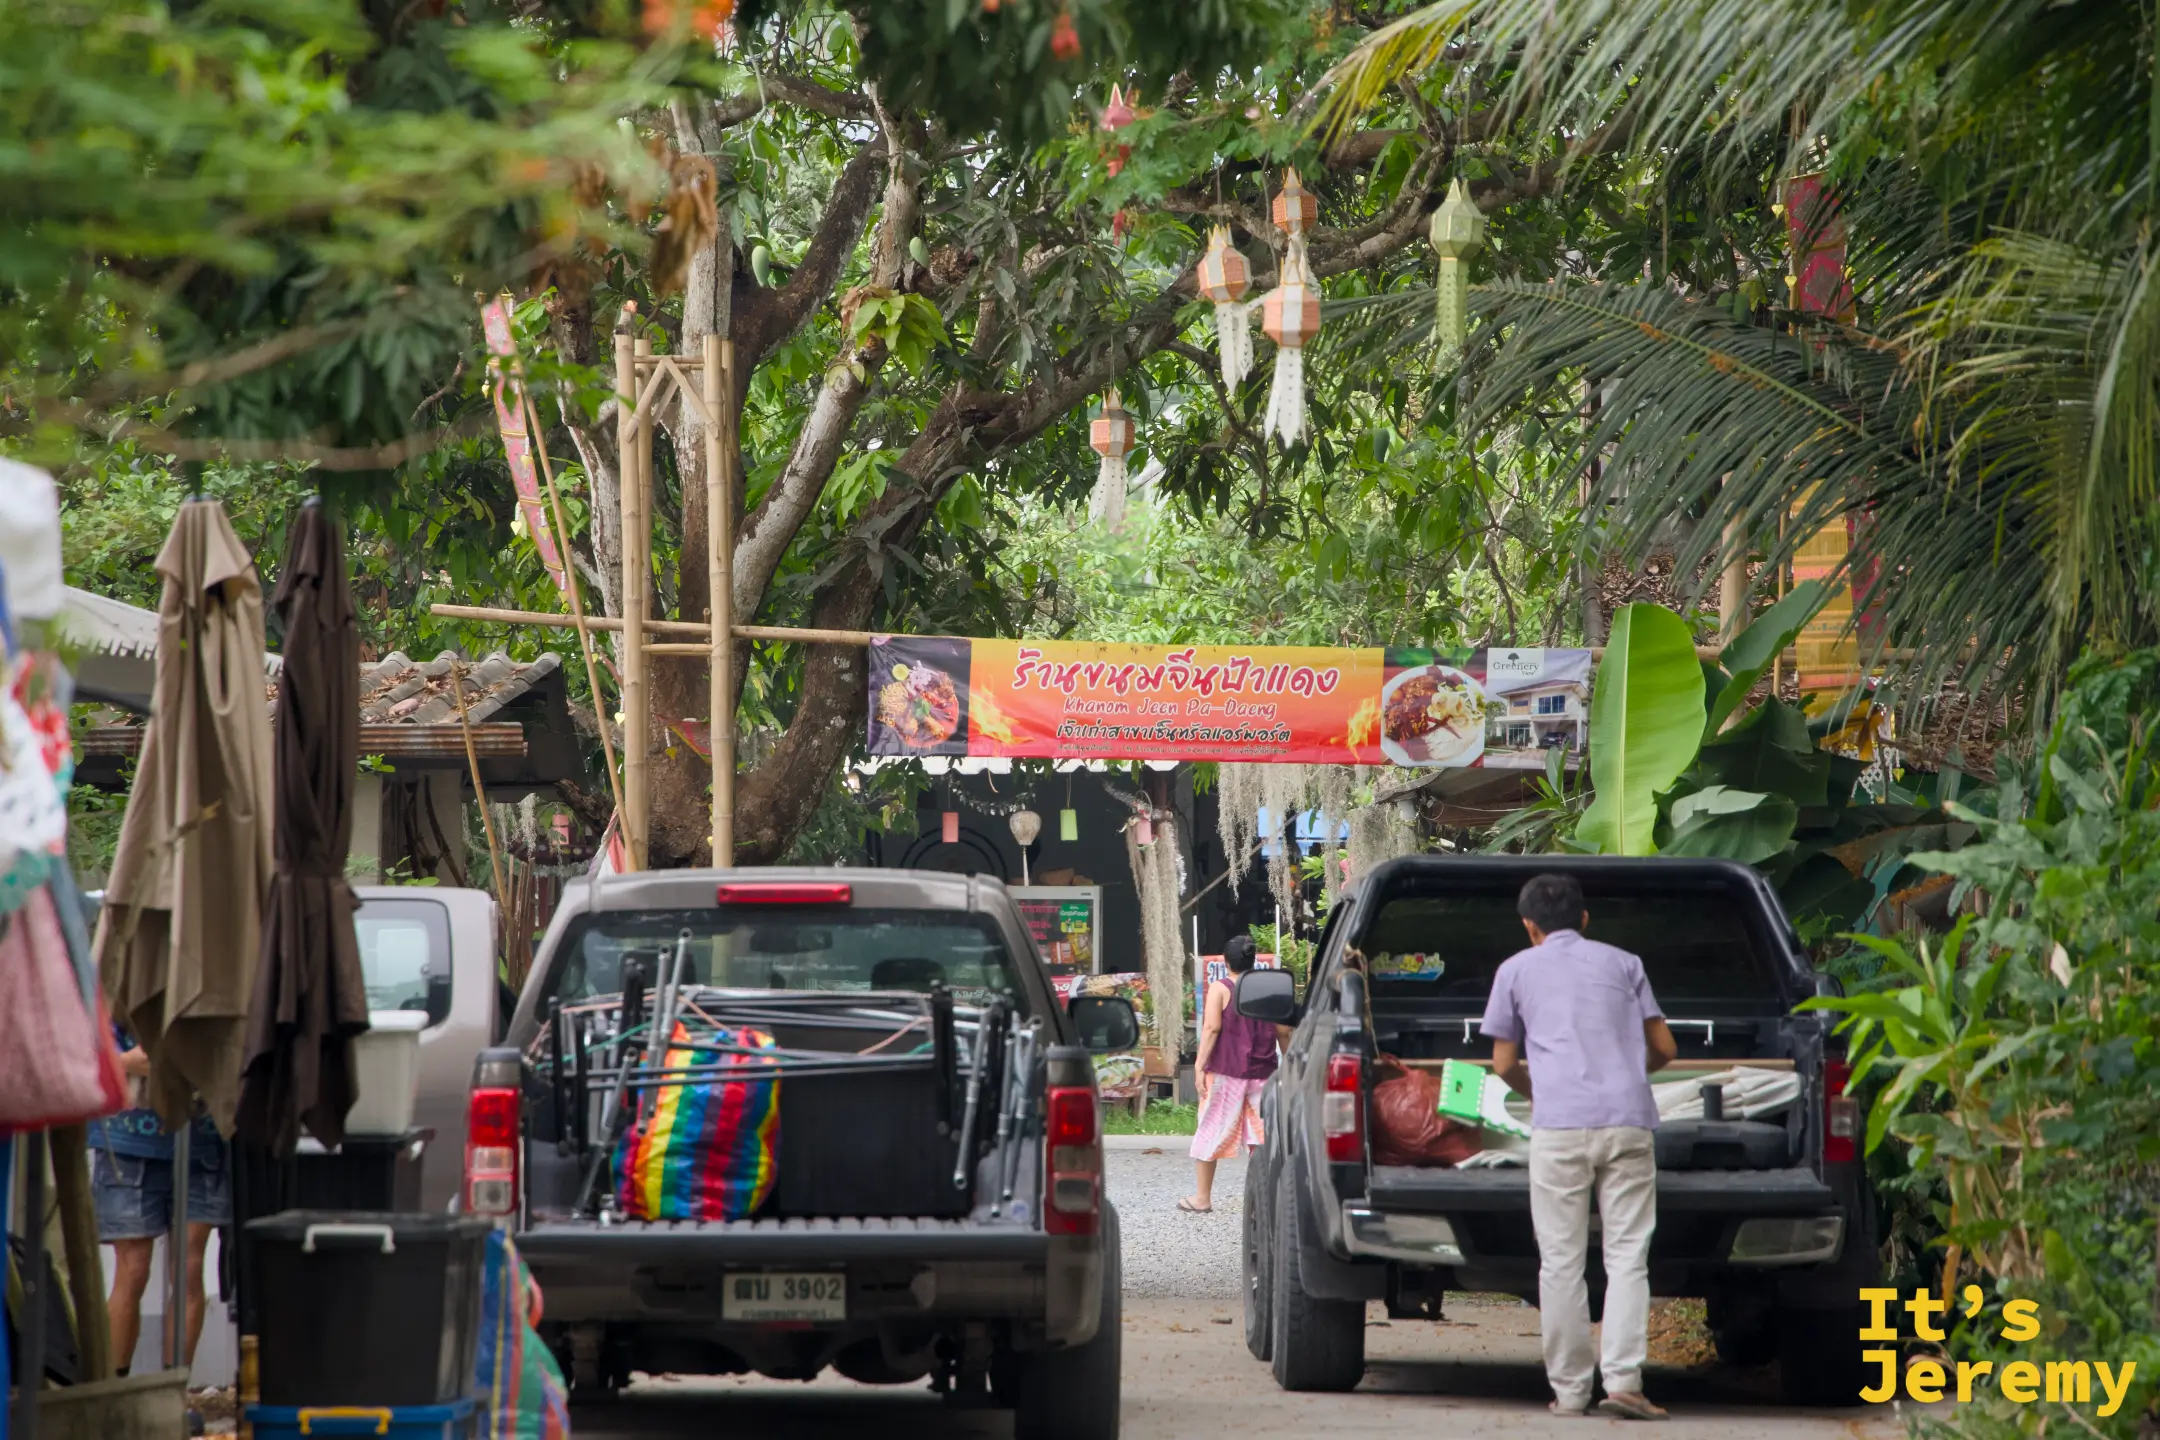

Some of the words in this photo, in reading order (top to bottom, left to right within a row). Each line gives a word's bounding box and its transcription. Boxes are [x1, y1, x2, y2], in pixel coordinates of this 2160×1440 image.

[1012, 647, 1341, 698] ร้านขนมจีนป้าแดง
[1493, 661, 1539, 671] Greenery
[1063, 695, 1129, 714] Khanom
[1137, 697, 1179, 715] Jeen
[783, 1276, 842, 1301] 3902
